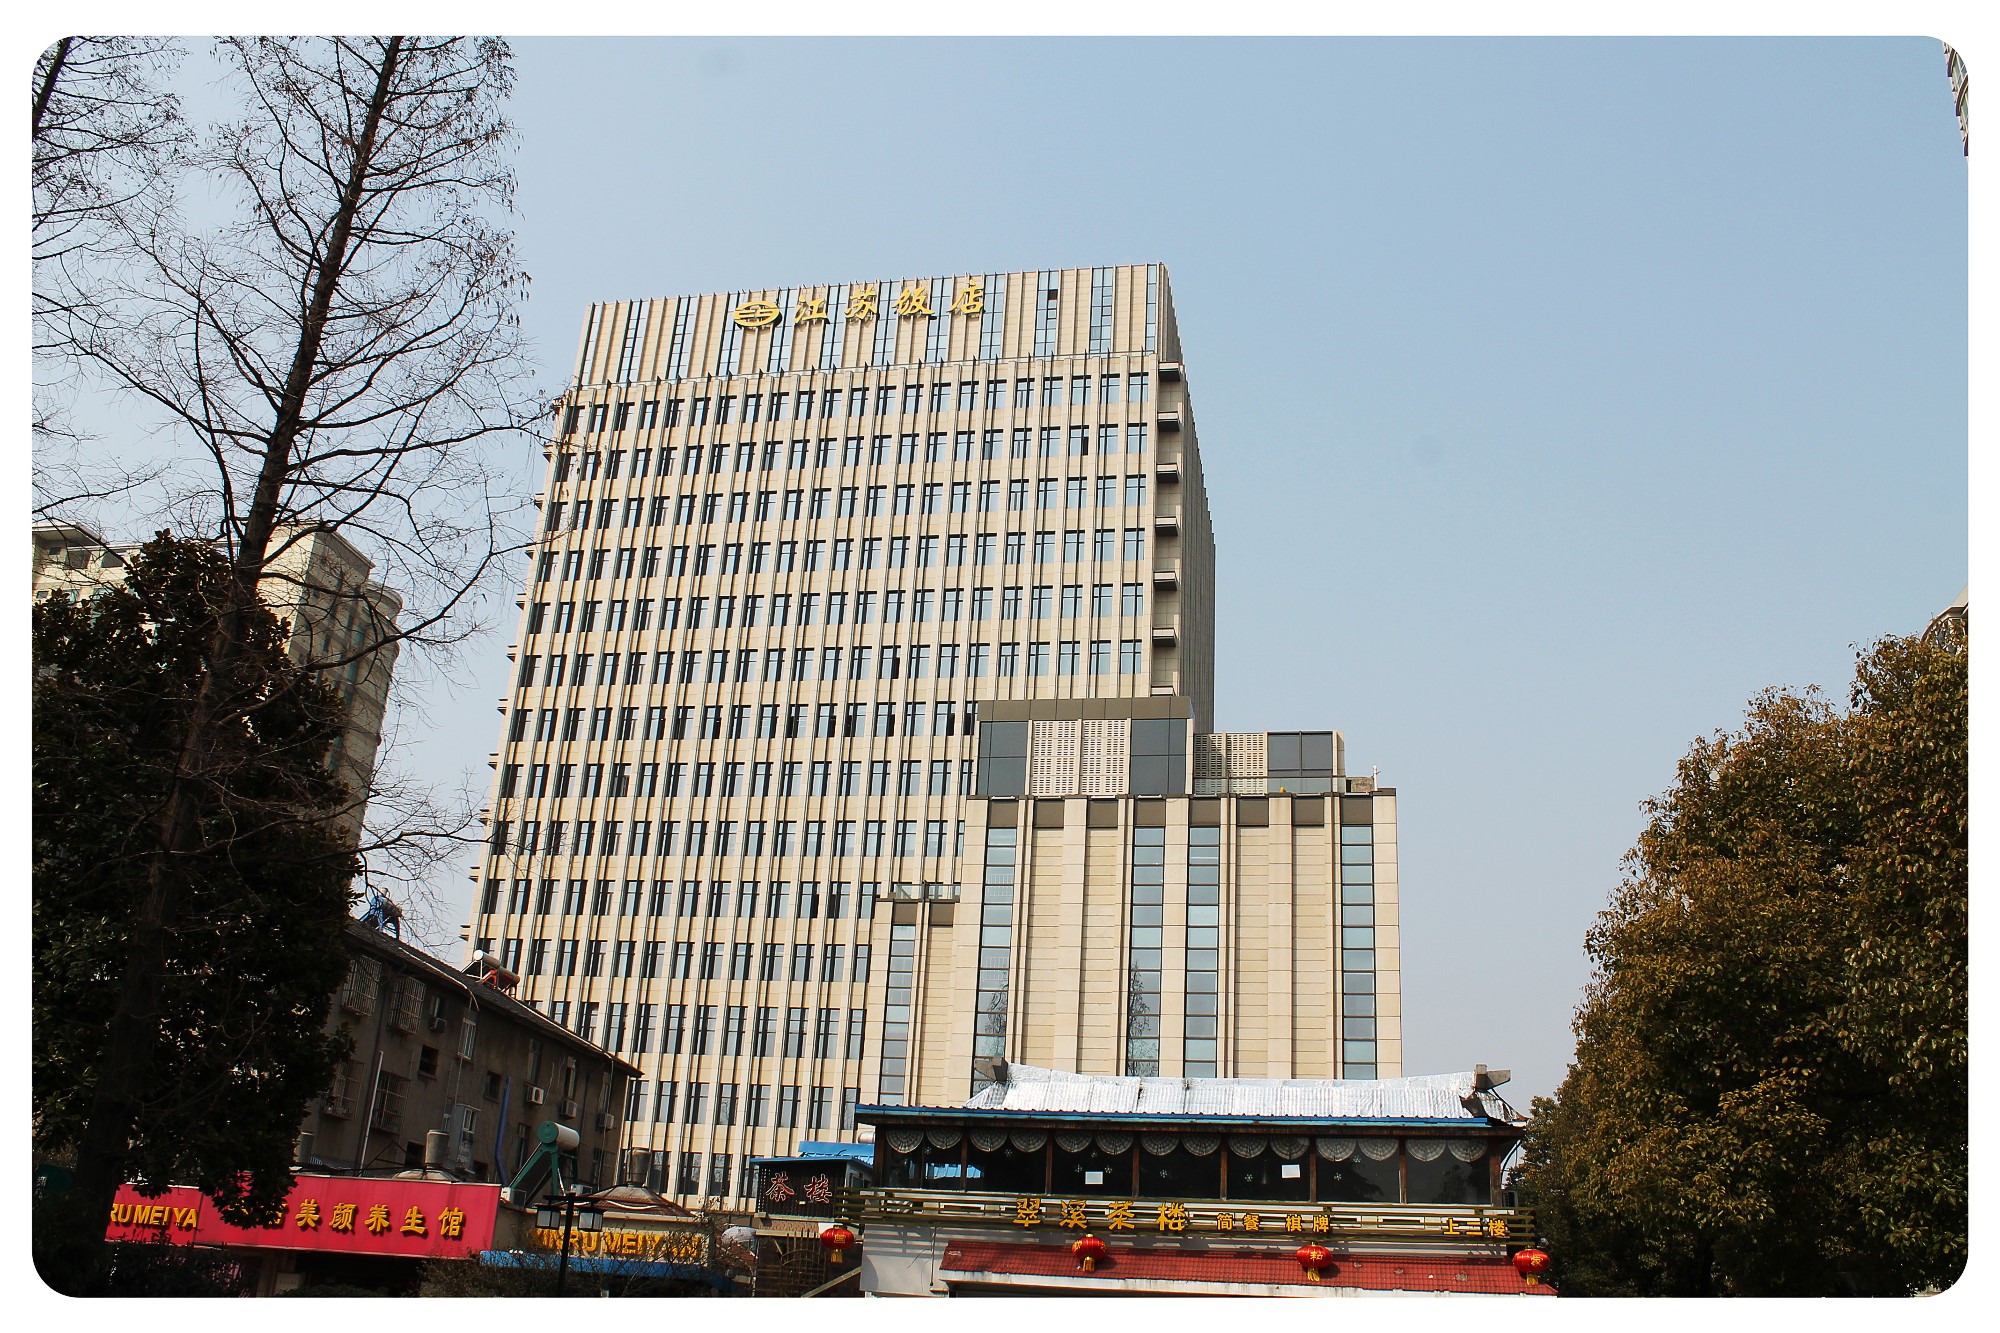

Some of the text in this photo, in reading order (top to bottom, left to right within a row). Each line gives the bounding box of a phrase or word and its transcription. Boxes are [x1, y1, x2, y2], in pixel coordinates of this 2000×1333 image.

[794, 280, 984, 323] 江苏饭店
[765, 1171, 832, 1204] 茶楼
[228, 1198, 466, 1237] 美颜养生馆
[1013, 1198, 1330, 1232] 翠溪茶楼 简餐 棋牌
[1443, 1218, 1507, 1237] 上二楼
